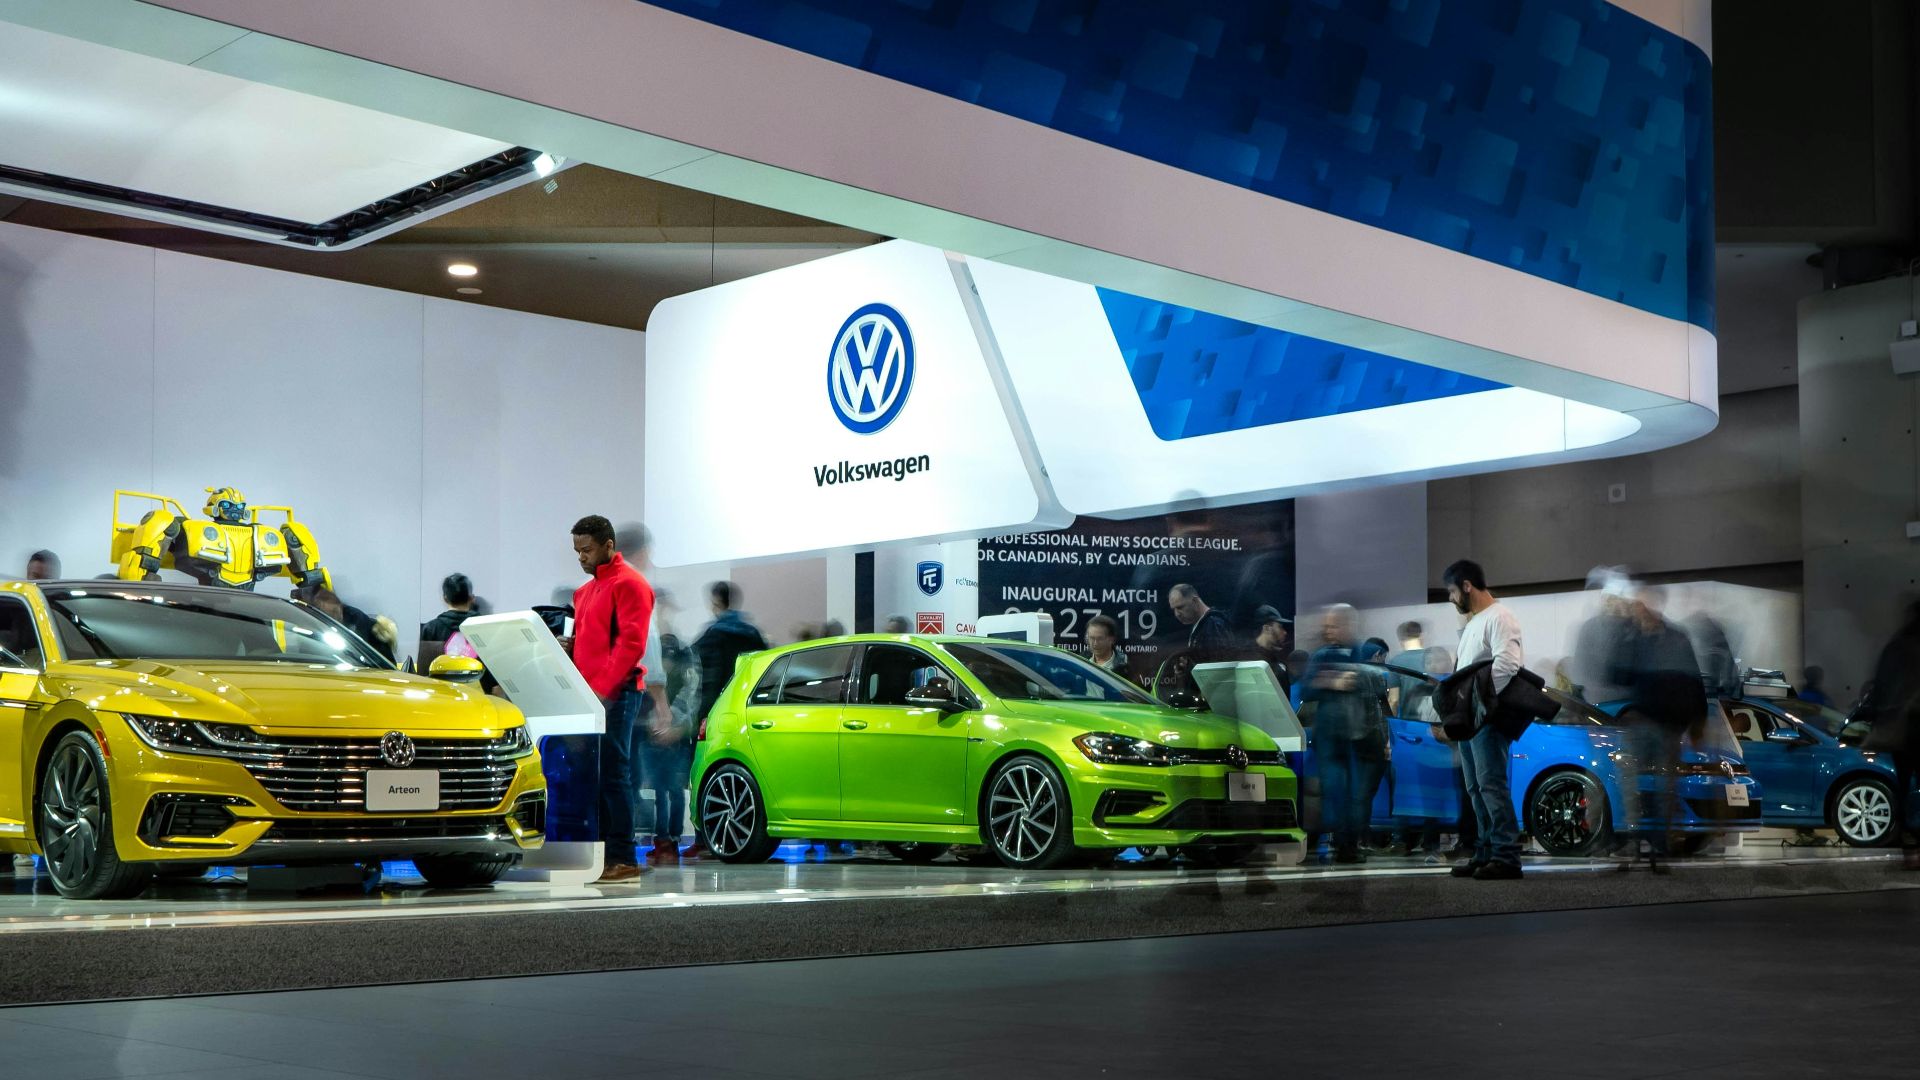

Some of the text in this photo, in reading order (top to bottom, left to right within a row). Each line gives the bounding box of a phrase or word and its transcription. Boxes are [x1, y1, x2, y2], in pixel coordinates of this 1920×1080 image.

[813, 454, 930, 487] Volkswagen
[1132, 536, 1185, 549] SOCCER
[1188, 537, 1242, 551] LEAGUE.
[998, 550, 1082, 566] CANADIANS,
[1085, 552, 1103, 564] BY
[1108, 553, 1191, 567] CANADIANS.
[1002, 586, 1158, 603] INAUGURAL MATCH
[1125, 644, 1158, 653] ONTARIO
[388, 785, 420, 794] Arteon
